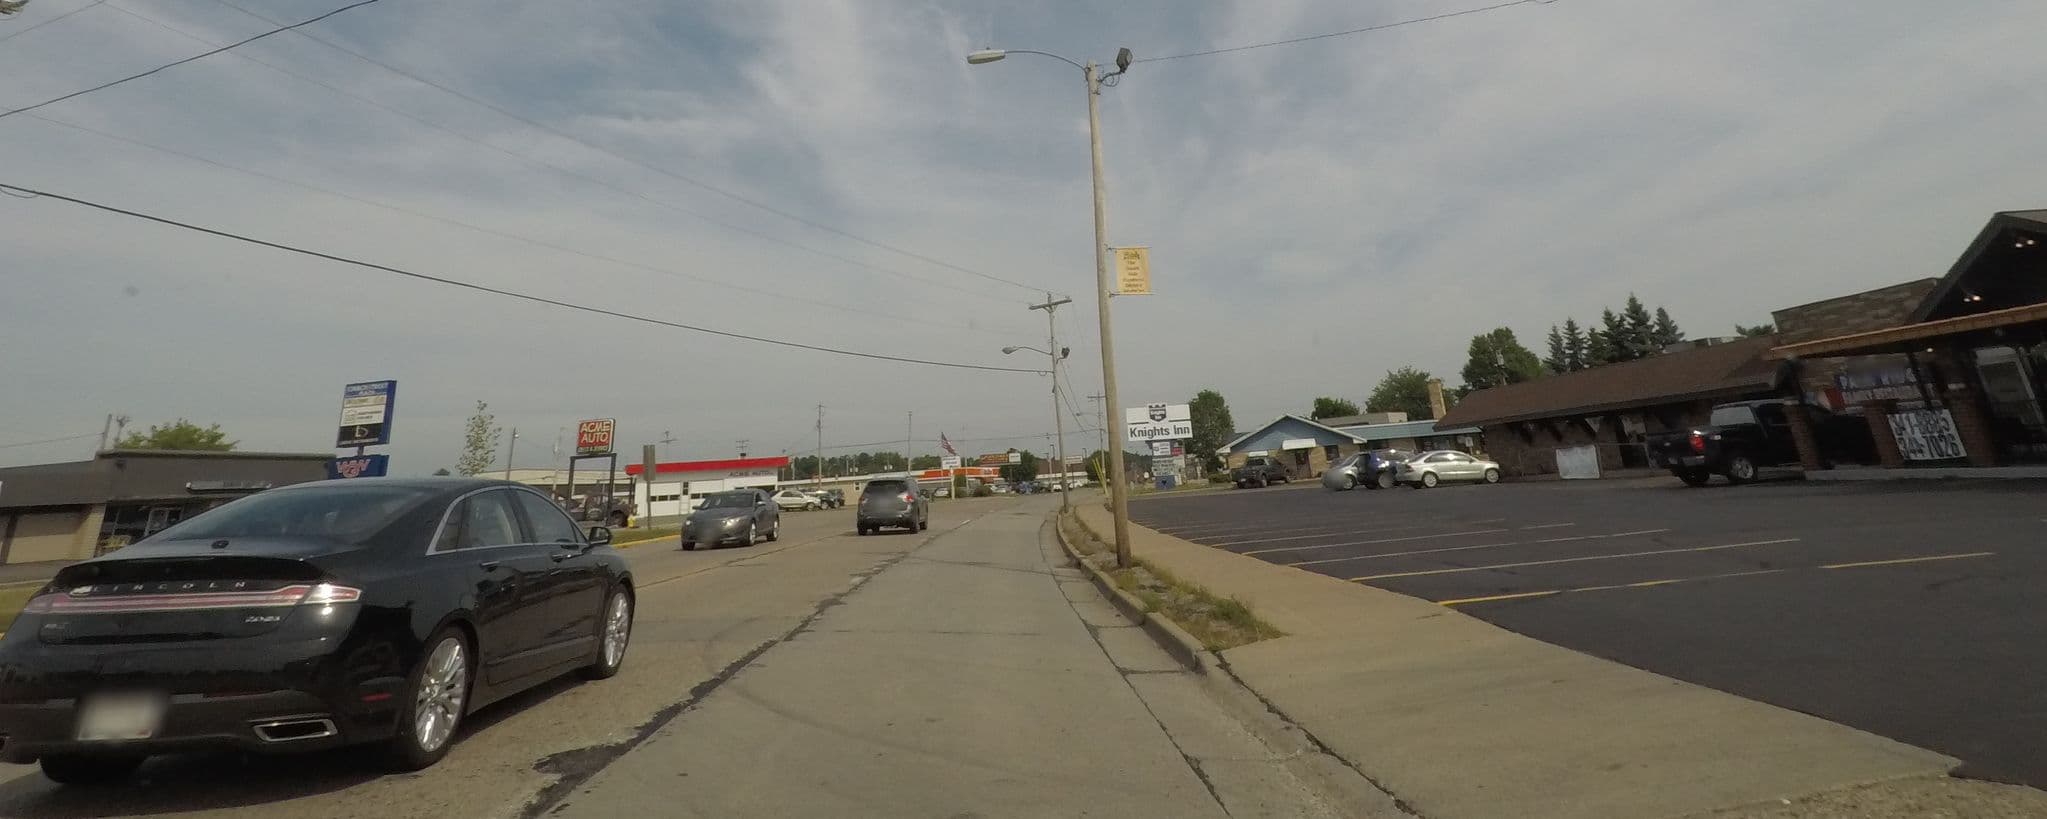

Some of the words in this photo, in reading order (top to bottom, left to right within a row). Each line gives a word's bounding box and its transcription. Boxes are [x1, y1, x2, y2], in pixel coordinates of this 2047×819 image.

[581, 421, 610, 433] ACME
[1129, 426, 1170, 439] Knights
[1173, 425, 1190, 435] Inn
[580, 432, 609, 444] AUTO
[92, 582, 246, 592] LINCOLN
